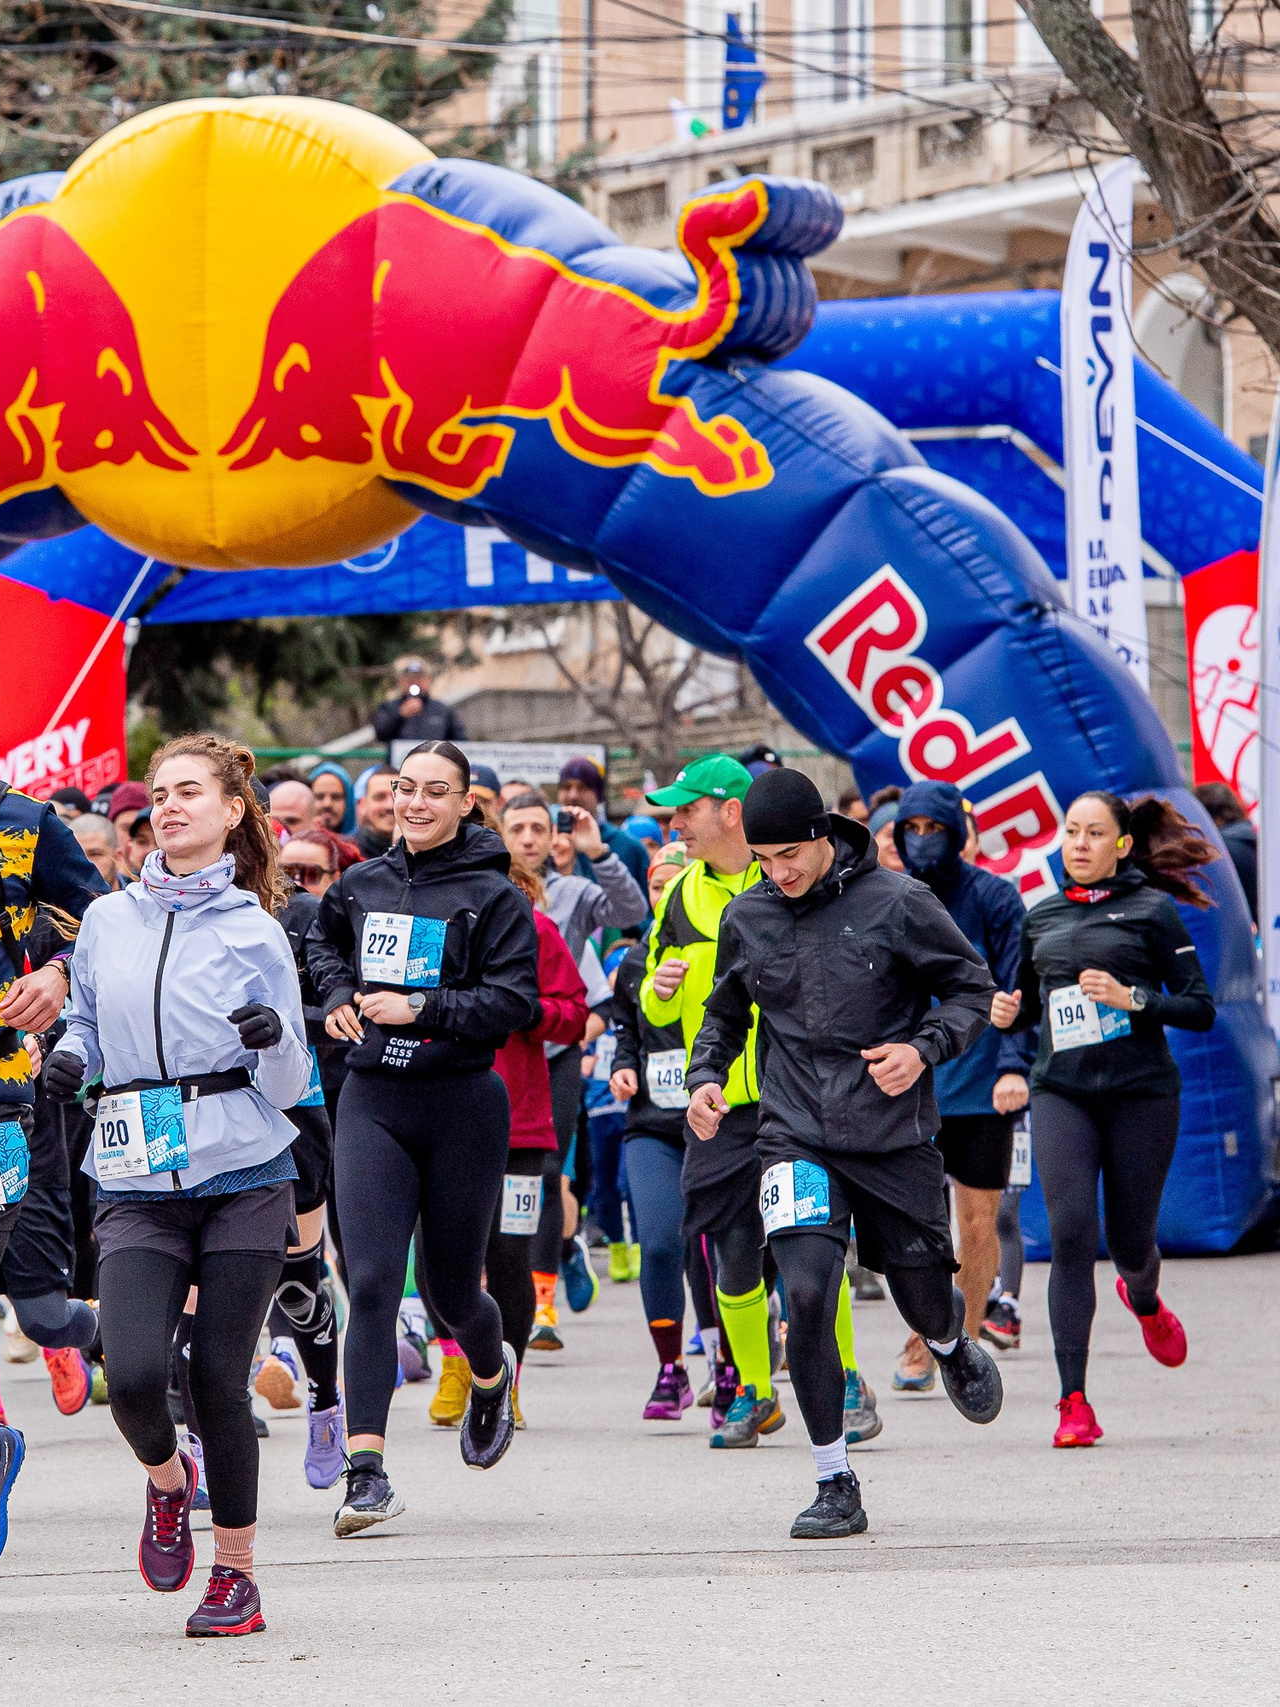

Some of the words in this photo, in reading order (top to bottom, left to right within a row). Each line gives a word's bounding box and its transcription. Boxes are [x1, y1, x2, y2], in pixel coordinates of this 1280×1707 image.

[813, 573, 1024, 786] Red
[367, 932, 398, 957] 272
[1057, 1003, 1086, 1026] 194
[385, 1045, 413, 1058] RESS
[389, 1037, 421, 1048] COMP
[381, 1055, 410, 1068] PORT
[657, 1067, 683, 1086] 148
[101, 1119, 130, 1149] 120
[515, 1193, 536, 1212] 191
[761, 1184, 780, 1213] 158
